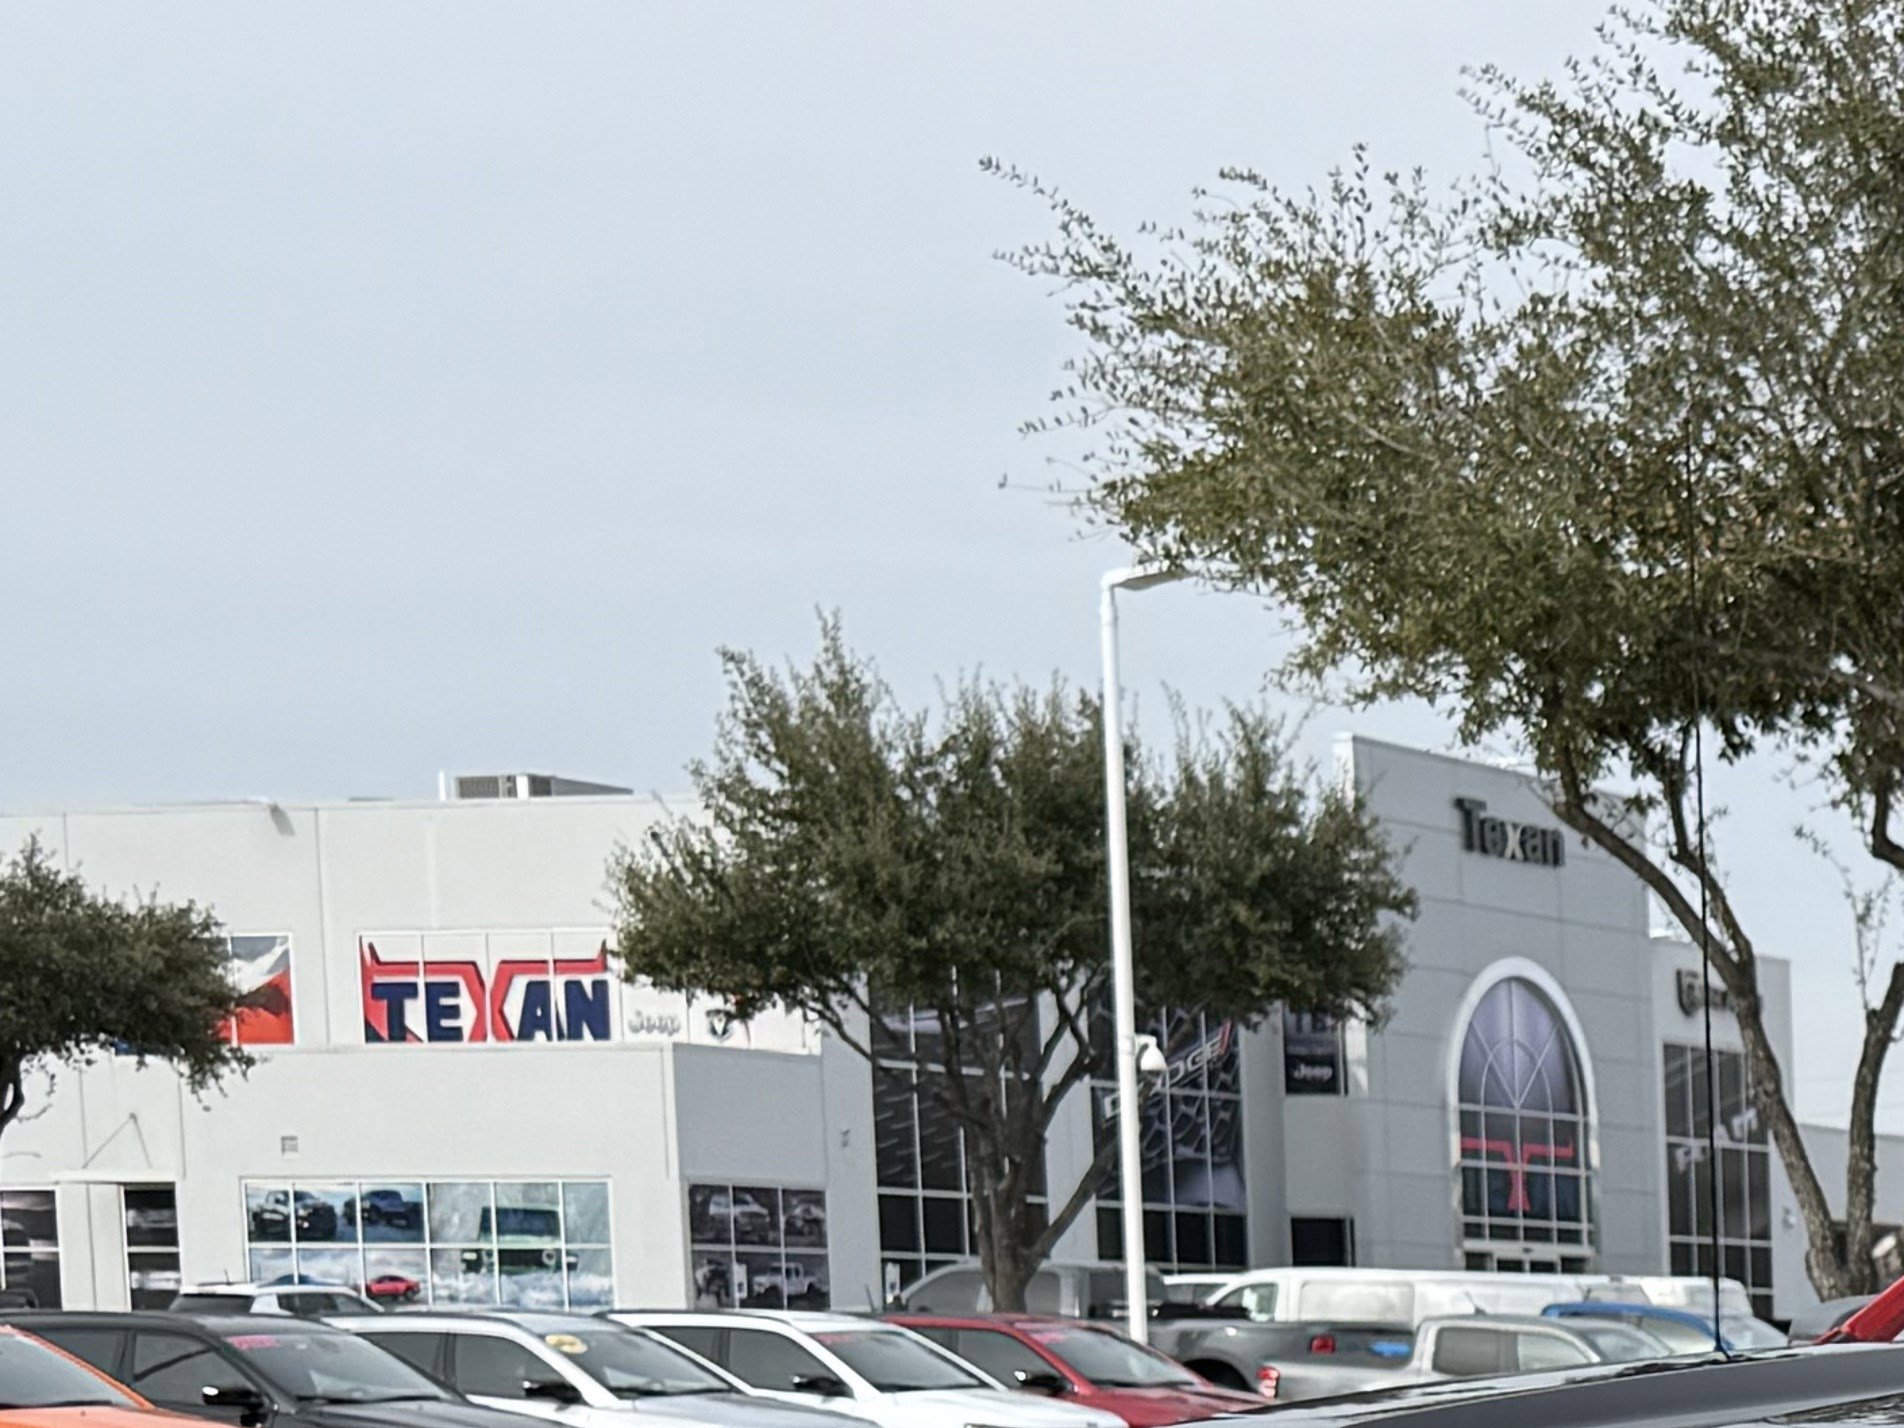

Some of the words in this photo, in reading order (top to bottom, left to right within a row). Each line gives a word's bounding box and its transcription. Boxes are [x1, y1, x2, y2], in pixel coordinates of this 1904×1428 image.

[1453, 797, 1566, 868] Texan
[366, 960, 611, 1043] TEXAN
[1104, 1034, 1226, 1120] DDGE
